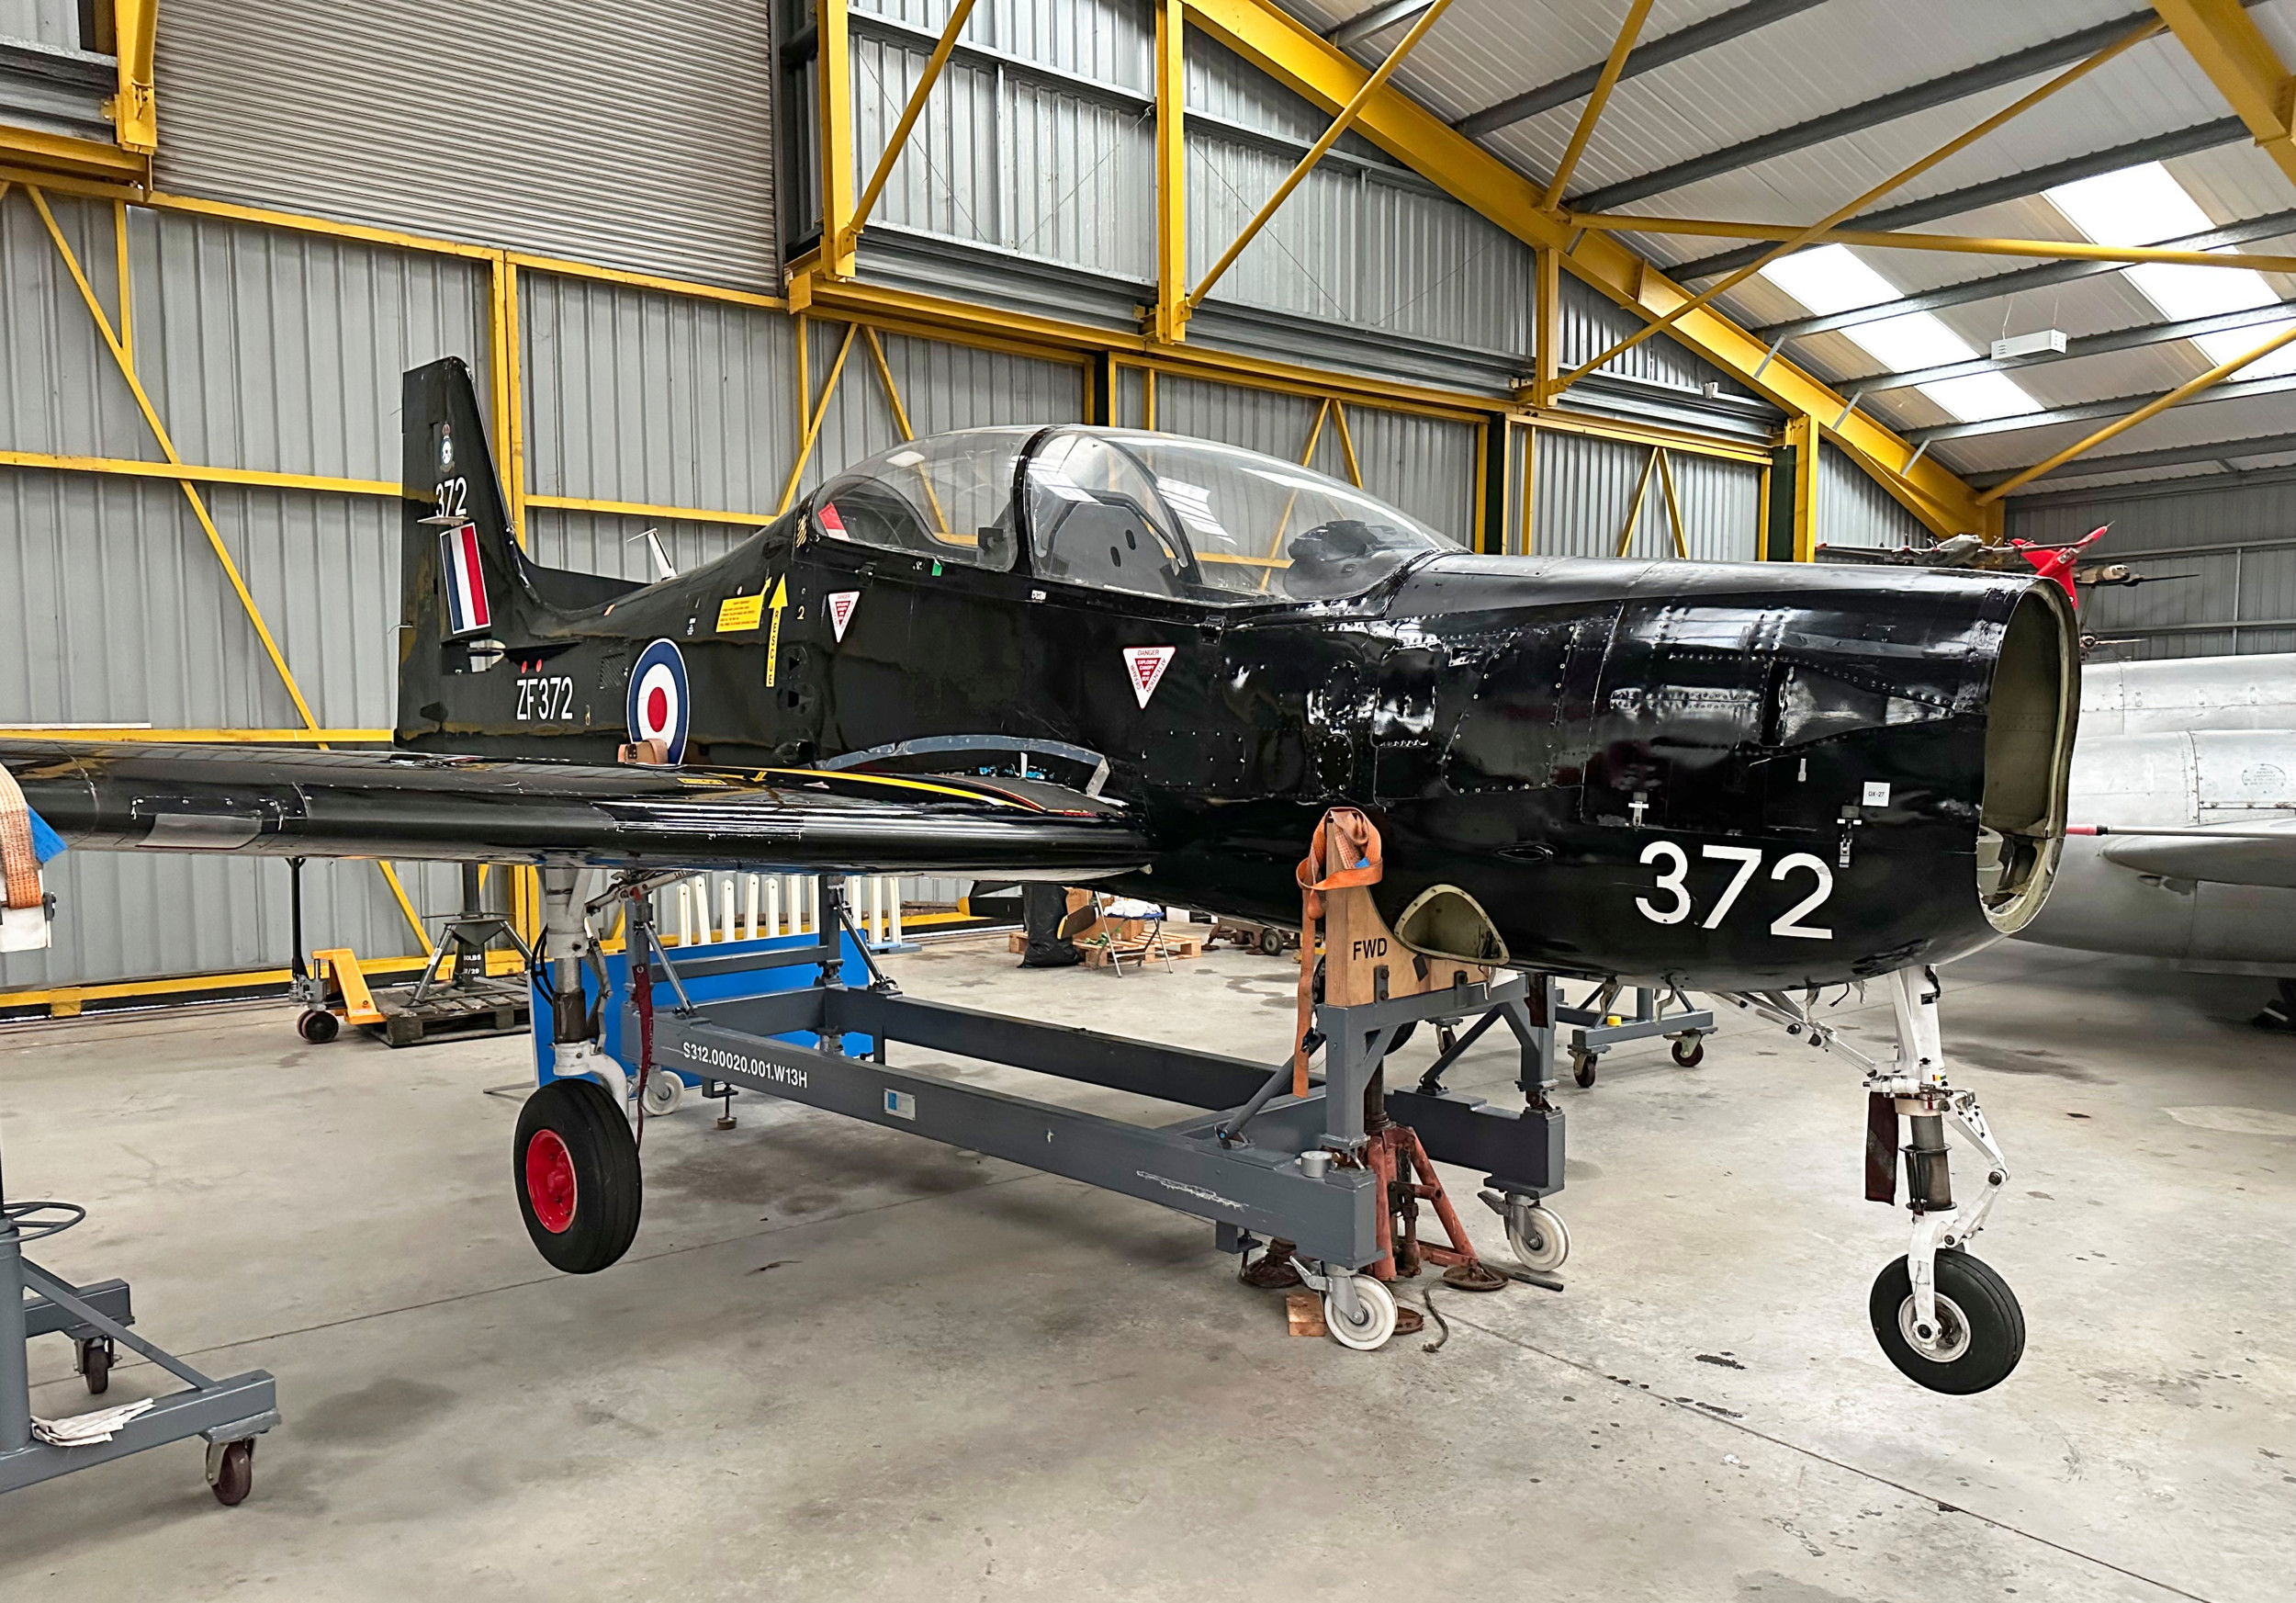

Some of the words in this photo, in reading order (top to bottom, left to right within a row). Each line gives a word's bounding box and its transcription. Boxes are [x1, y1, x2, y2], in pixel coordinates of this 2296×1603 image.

[435, 477, 467, 517] 372
[797, 605, 805, 620] 2
[768, 610, 780, 684] RESCUE
[1145, 658, 1166, 694] ATTENTION
[517, 676, 573, 720] ZF372
[1636, 841, 1833, 940] 372
[1353, 937, 1388, 961] FWD
[682, 1042, 807, 1089] S312.00020.001.W13H
